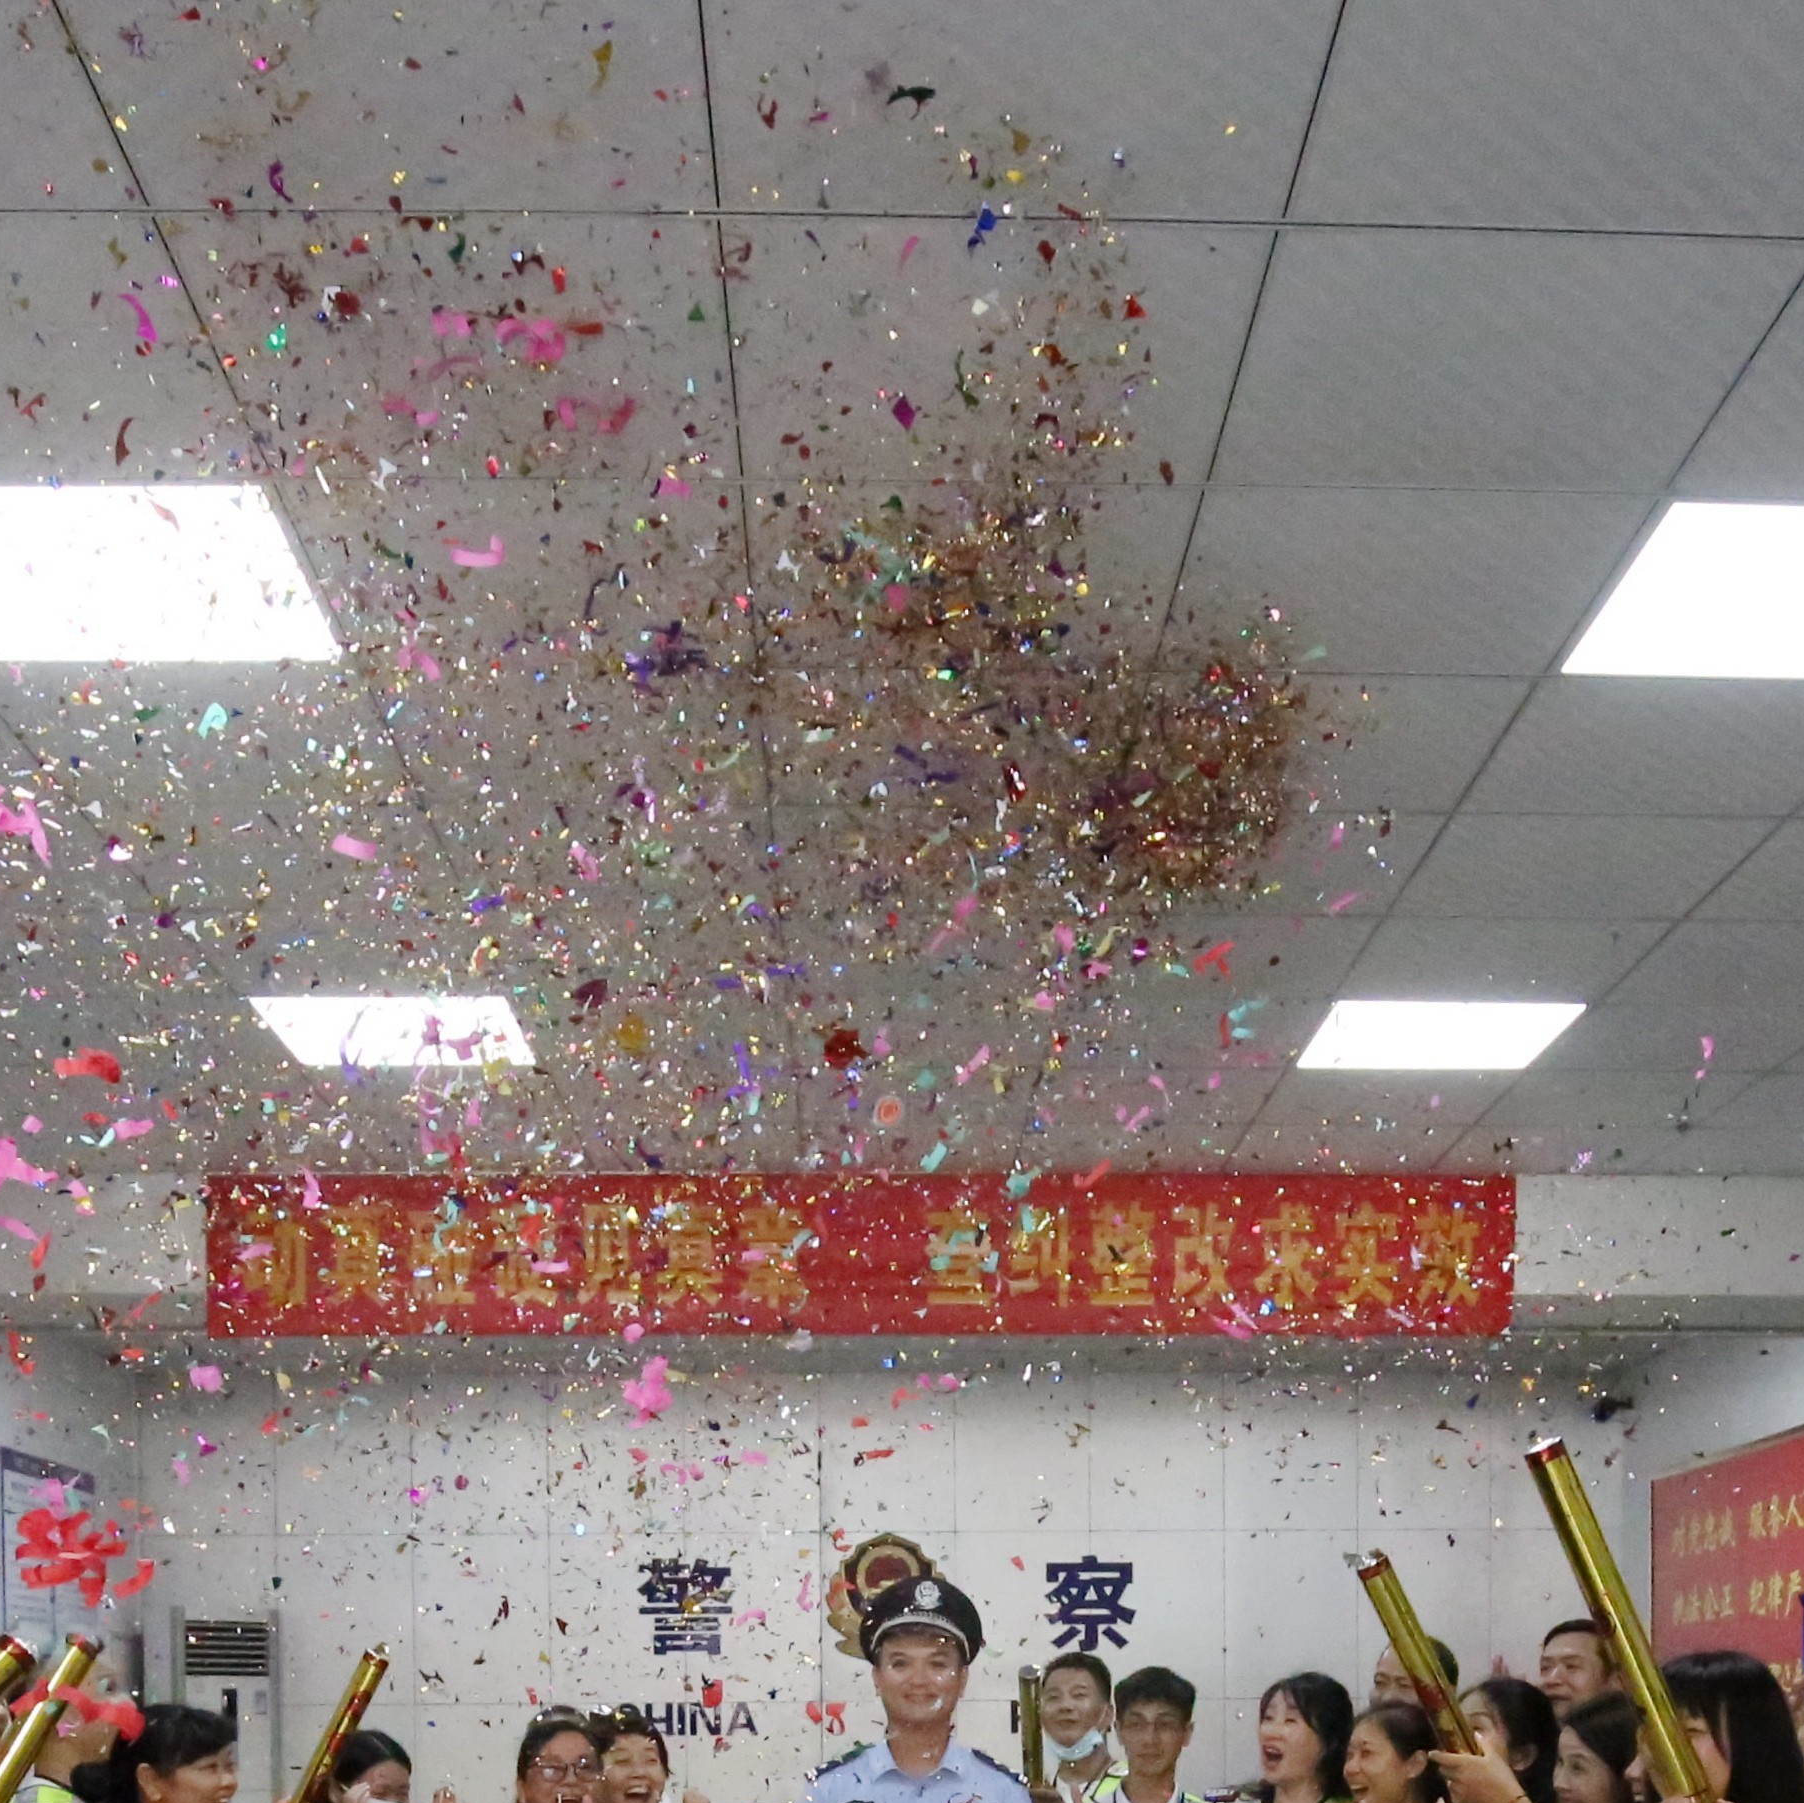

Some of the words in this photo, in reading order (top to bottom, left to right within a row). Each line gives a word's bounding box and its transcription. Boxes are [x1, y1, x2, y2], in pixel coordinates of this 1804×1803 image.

[928, 1202, 1480, 1306] 查纠整改求实效
[638, 1557, 733, 1656] 警
[1045, 1555, 1136, 1653] 察
